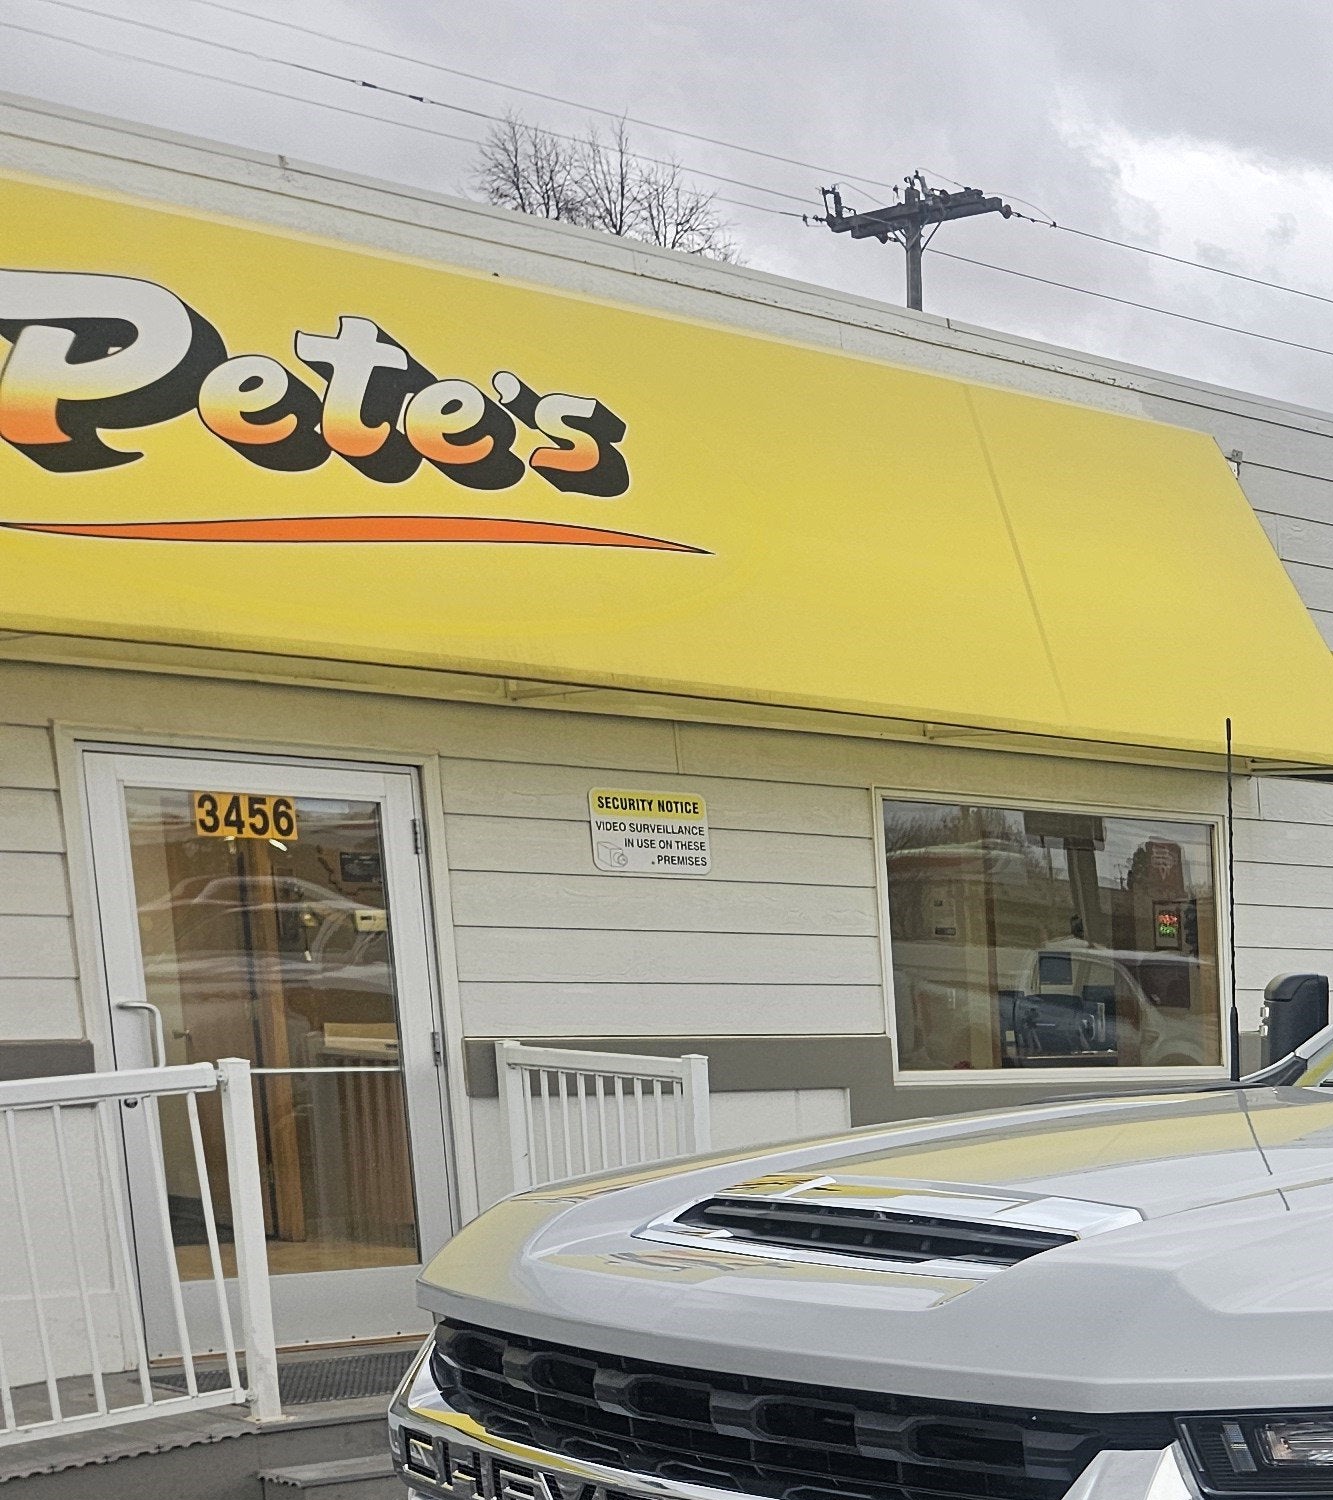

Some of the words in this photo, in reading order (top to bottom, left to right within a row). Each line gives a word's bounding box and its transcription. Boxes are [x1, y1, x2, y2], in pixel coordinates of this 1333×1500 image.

[0, 269, 629, 497] Pete's
[597, 796, 653, 811] SECURITY
[658, 800, 699, 814] NOTICE
[197, 794, 294, 837] 3456
[595, 820, 626, 832] VIDEO
[628, 822, 705, 836] SURVEILLANCE
[624, 838, 634, 848] IN
[637, 839, 656, 849] USE
[659, 840, 673, 850] ON
[675, 840, 706, 851] THESE
[657, 855, 707, 867] PREMISES
